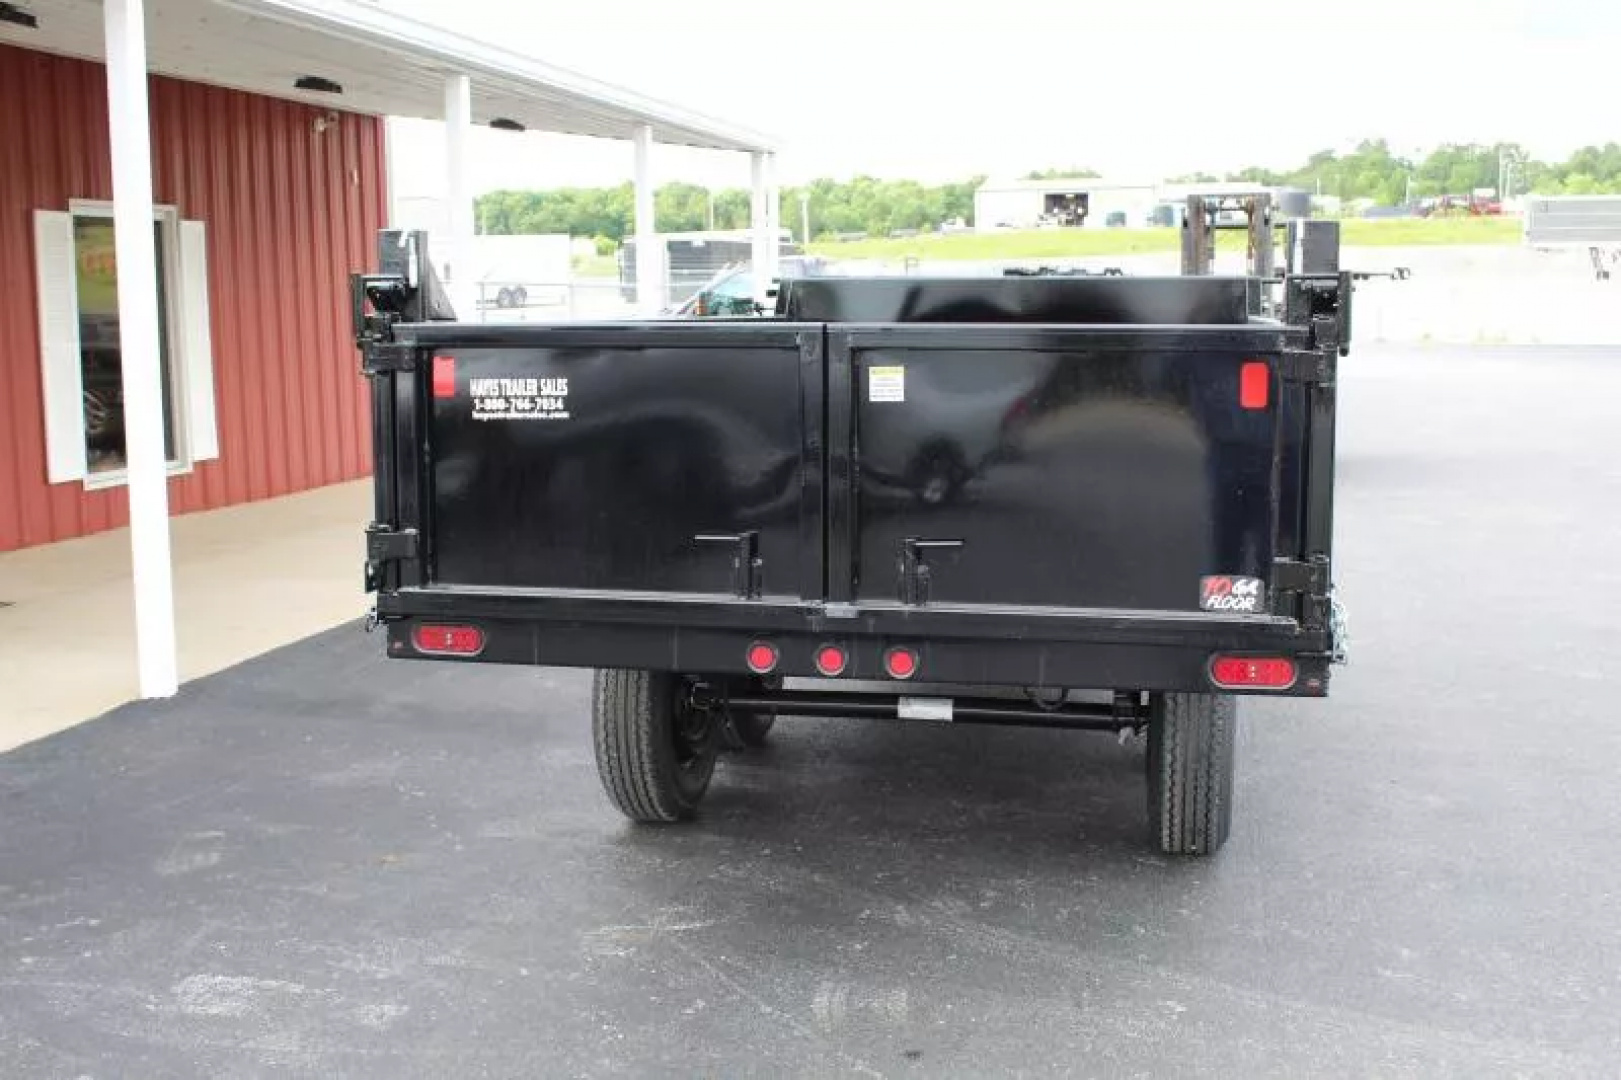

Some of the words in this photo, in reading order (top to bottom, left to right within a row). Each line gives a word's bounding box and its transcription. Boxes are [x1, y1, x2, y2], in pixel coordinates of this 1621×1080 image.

[500, 378, 538, 396] TRAILER
[540, 378, 568, 396] SALES
[1207, 595, 1255, 611] FLOOR
